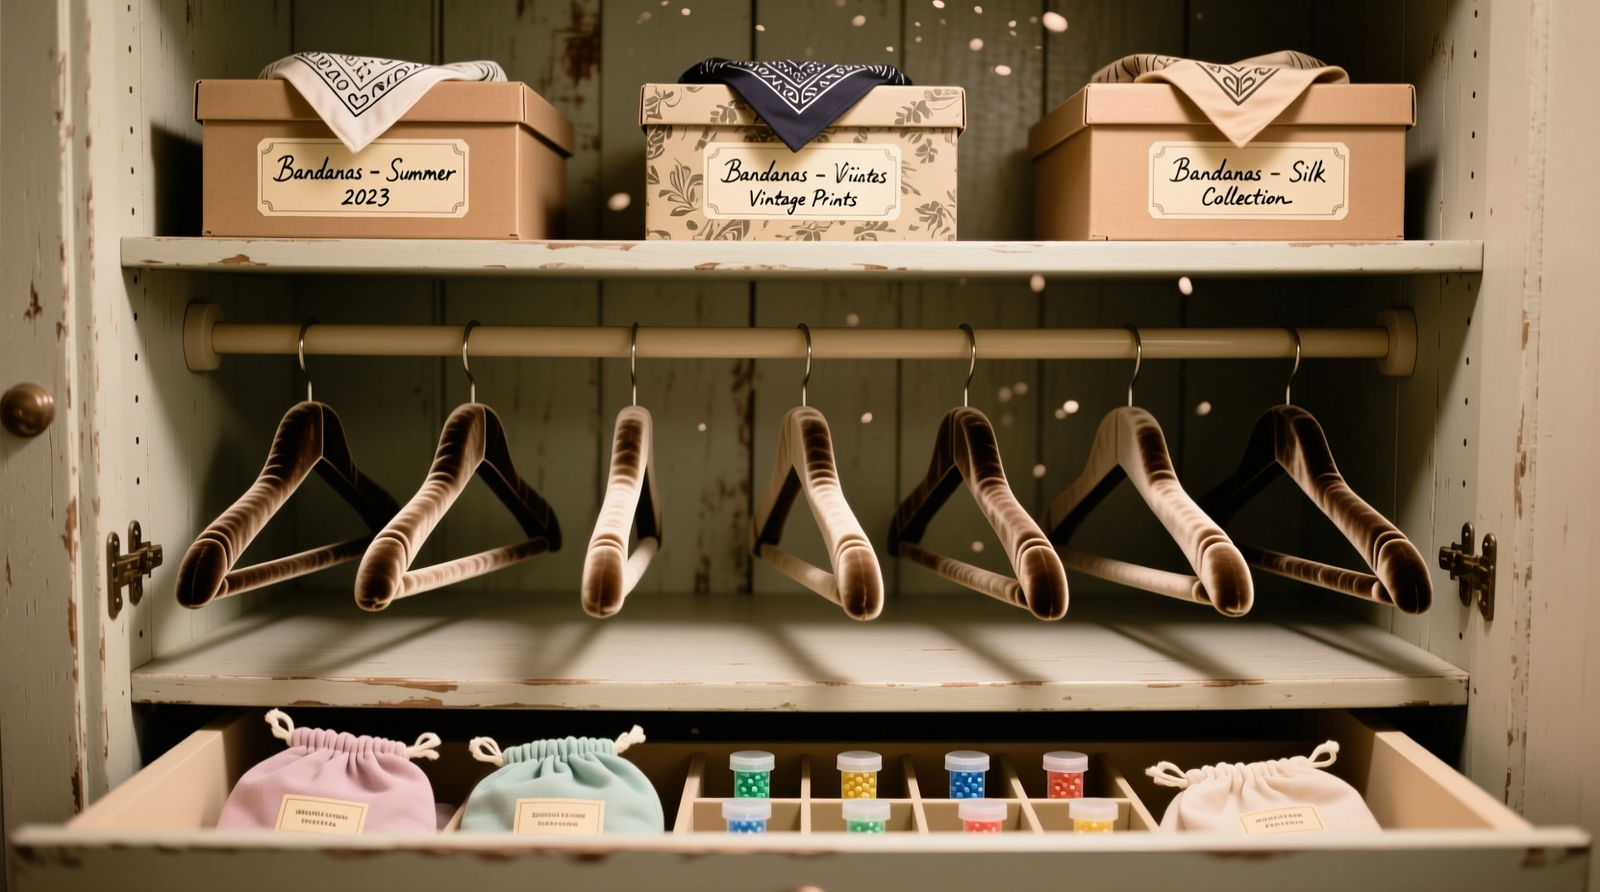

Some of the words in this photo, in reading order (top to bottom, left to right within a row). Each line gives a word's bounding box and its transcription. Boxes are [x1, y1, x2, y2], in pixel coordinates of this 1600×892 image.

[273, 154, 363, 183] Bandanas
[386, 157, 457, 183] Summer
[720, 157, 808, 184] Bandanas
[1169, 156, 1262, 183] Bandanas
[1289, 159, 1326, 184] Silk
[341, 187, 390, 207] 2023
[749, 188, 806, 216] Vintage
[811, 188, 858, 208] Prints
[1201, 185, 1293, 207] Collection
